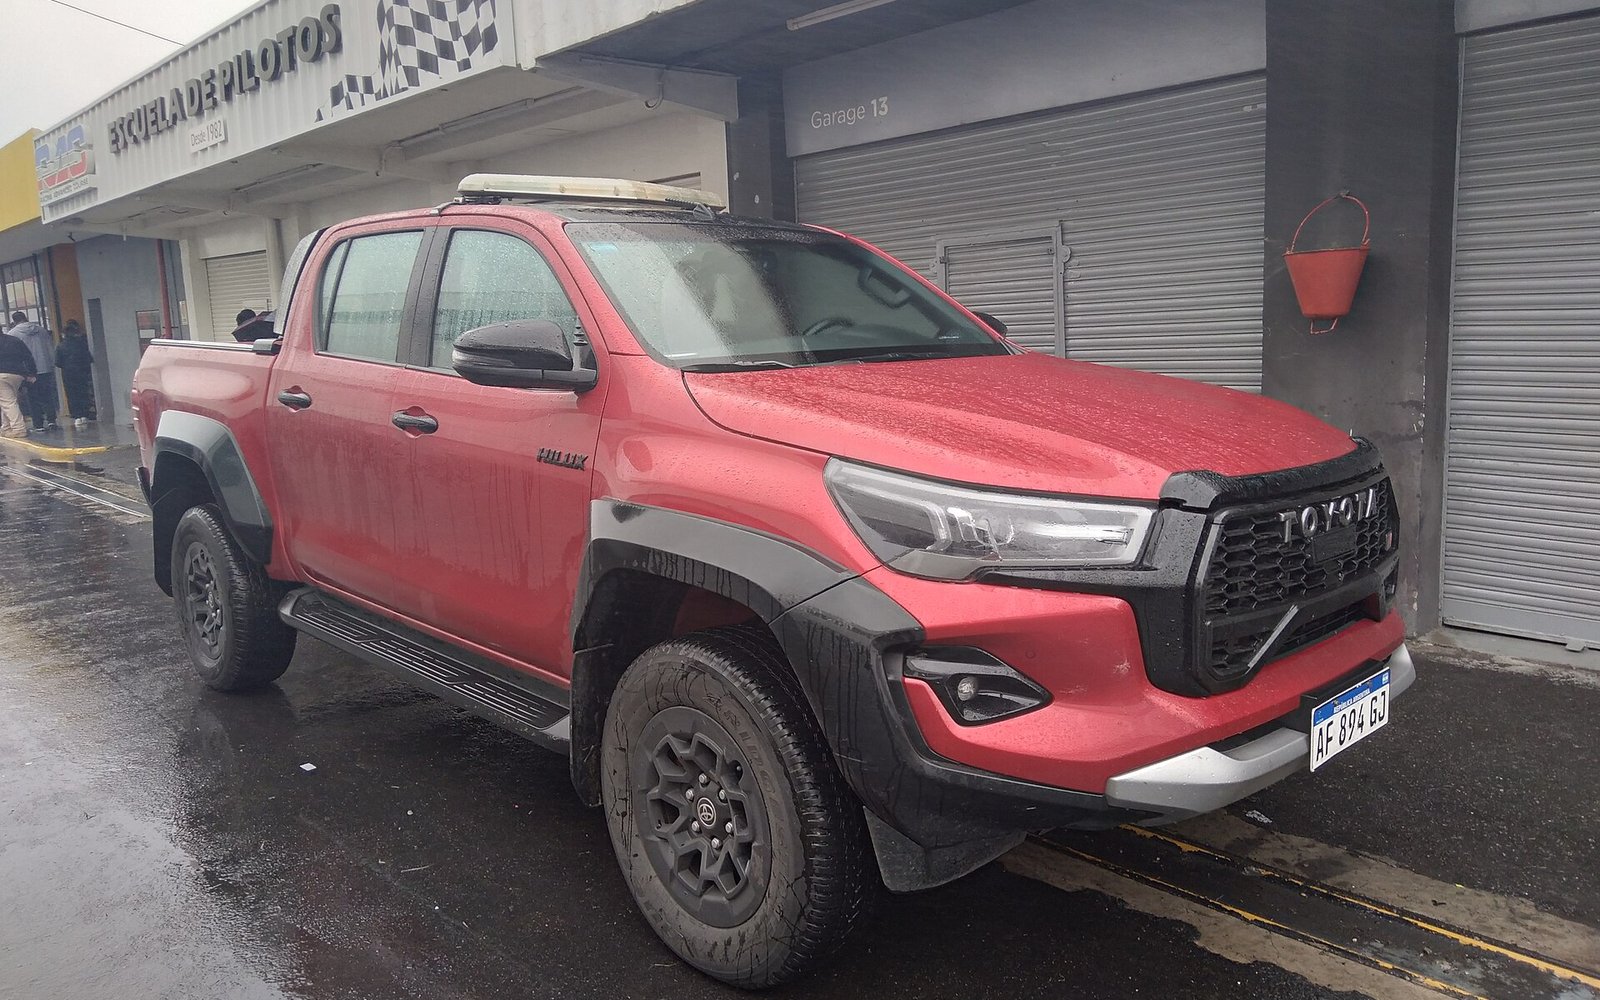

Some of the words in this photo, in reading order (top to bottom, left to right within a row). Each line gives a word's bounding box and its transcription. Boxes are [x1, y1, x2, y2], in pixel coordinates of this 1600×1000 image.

[108, 87, 187, 153] ESCUELA
[185, 68, 217, 117] DE
[216, 3, 343, 102] PILOTOS
[811, 105, 866, 129] Garage
[870, 96, 889, 118] 13
[190, 130, 206, 147] Desde
[206, 124, 223, 143] 1982
[537, 447, 588, 471] HILUX
[1279, 488, 1377, 544] TOYOTA
[1316, 720, 1334, 762] AF
[1339, 703, 1364, 746] 894
[1369, 690, 1386, 728] GJ
